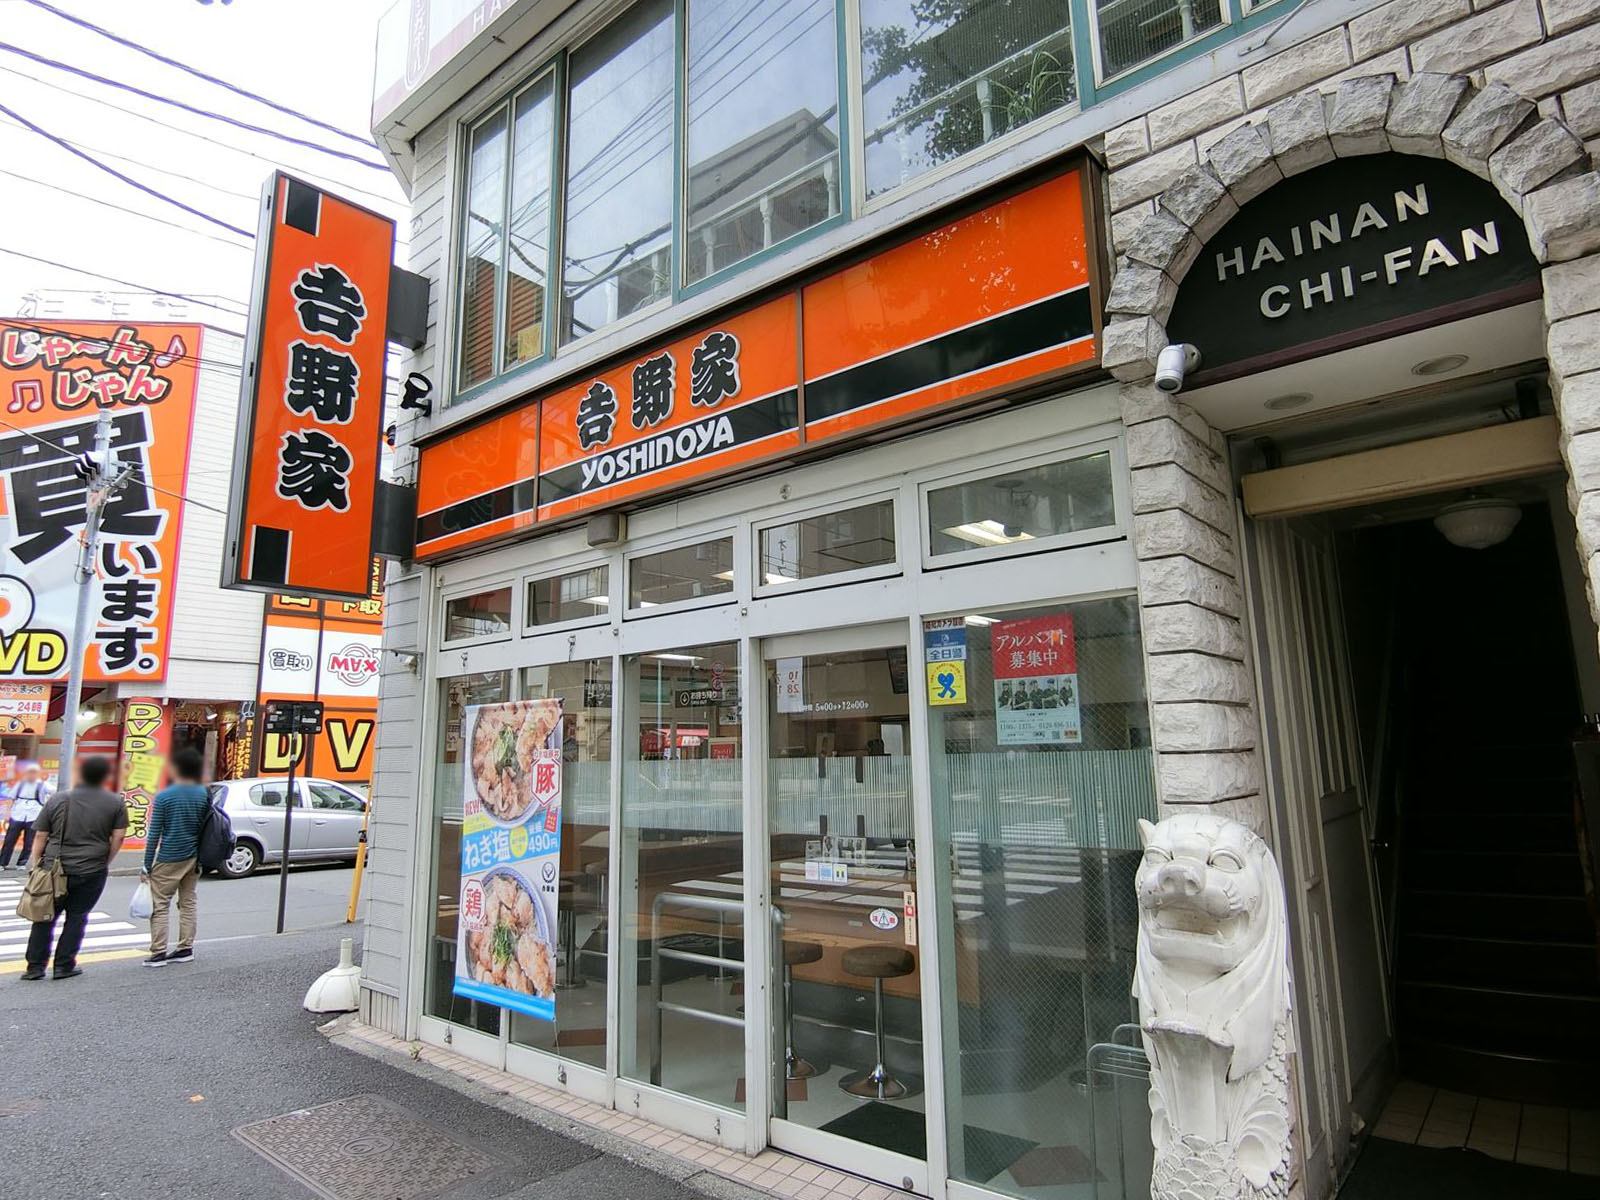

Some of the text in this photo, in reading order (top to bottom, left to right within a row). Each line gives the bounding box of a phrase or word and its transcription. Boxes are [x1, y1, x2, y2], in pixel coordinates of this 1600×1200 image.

[1216, 183, 1430, 282] HAINAN
[1259, 221, 1500, 319] CHI-FAN
[56, 366, 169, 408] じゃん
[276, 265, 366, 512] 吉野家
[577, 331, 741, 451] 吉野家
[272, 651, 311, 668] 買取り
[1010, 648, 1058, 669] 募集中
[535, 763, 555, 794] 豚
[464, 828, 512, 870] ねぎ塩
[528, 833, 558, 853] 490円
